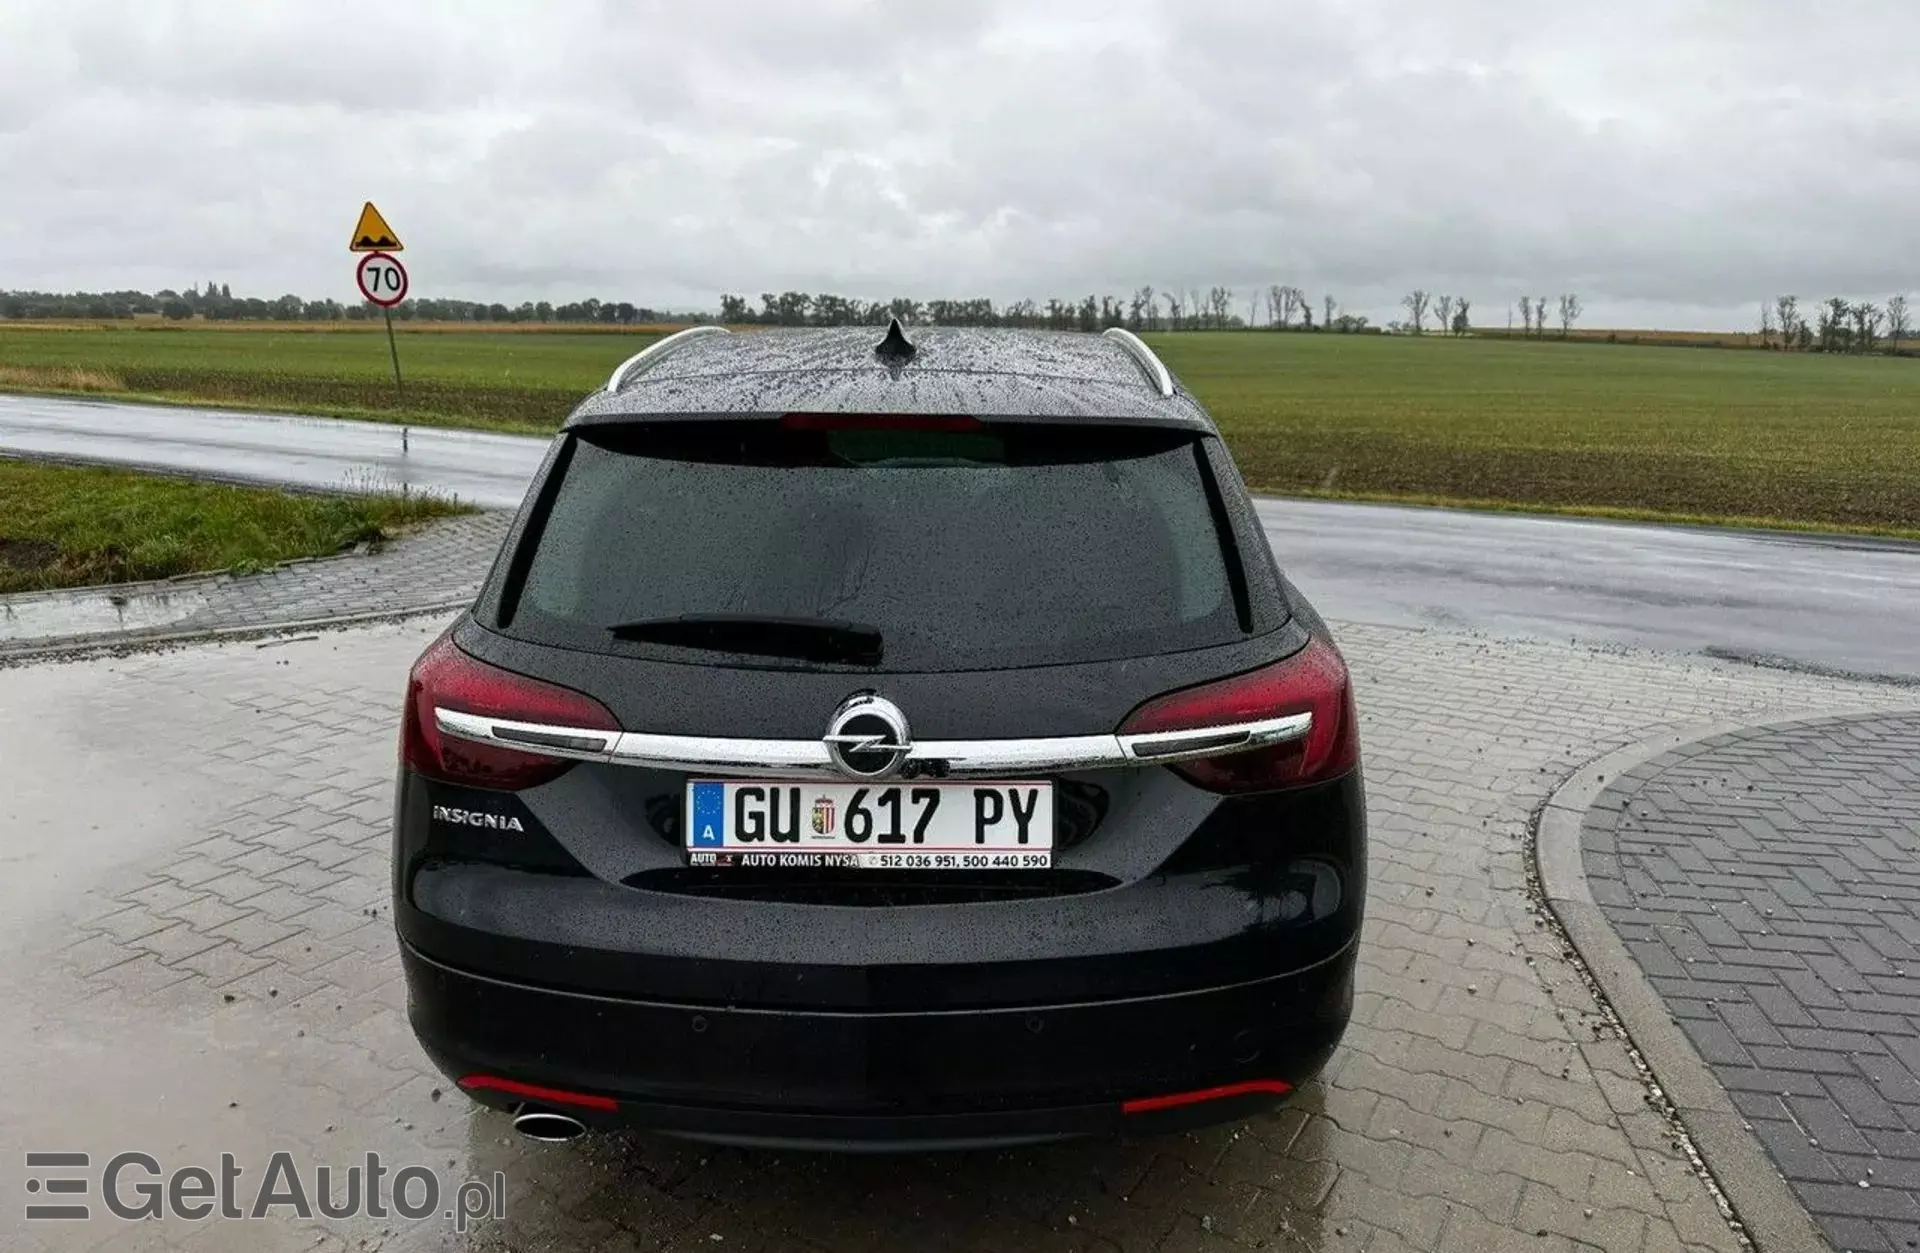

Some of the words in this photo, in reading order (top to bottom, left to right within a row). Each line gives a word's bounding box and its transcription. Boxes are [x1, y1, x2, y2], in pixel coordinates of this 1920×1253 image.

[366, 267, 401, 292] 70
[433, 805, 524, 832] INSIGNIA
[735, 787, 800, 843] GU
[844, 788, 941, 844] 617
[973, 788, 1039, 844] PY
[703, 825, 715, 840] A
[741, 854, 776, 867] AUTO
[780, 854, 822, 867] KOMIS
[825, 854, 859, 867] NYSA
[880, 855, 902, 867] 512
[906, 855, 931, 867] 036
[963, 855, 988, 867] 500
[992, 855, 1019, 867] 440
[1023, 855, 1047, 867] 590
